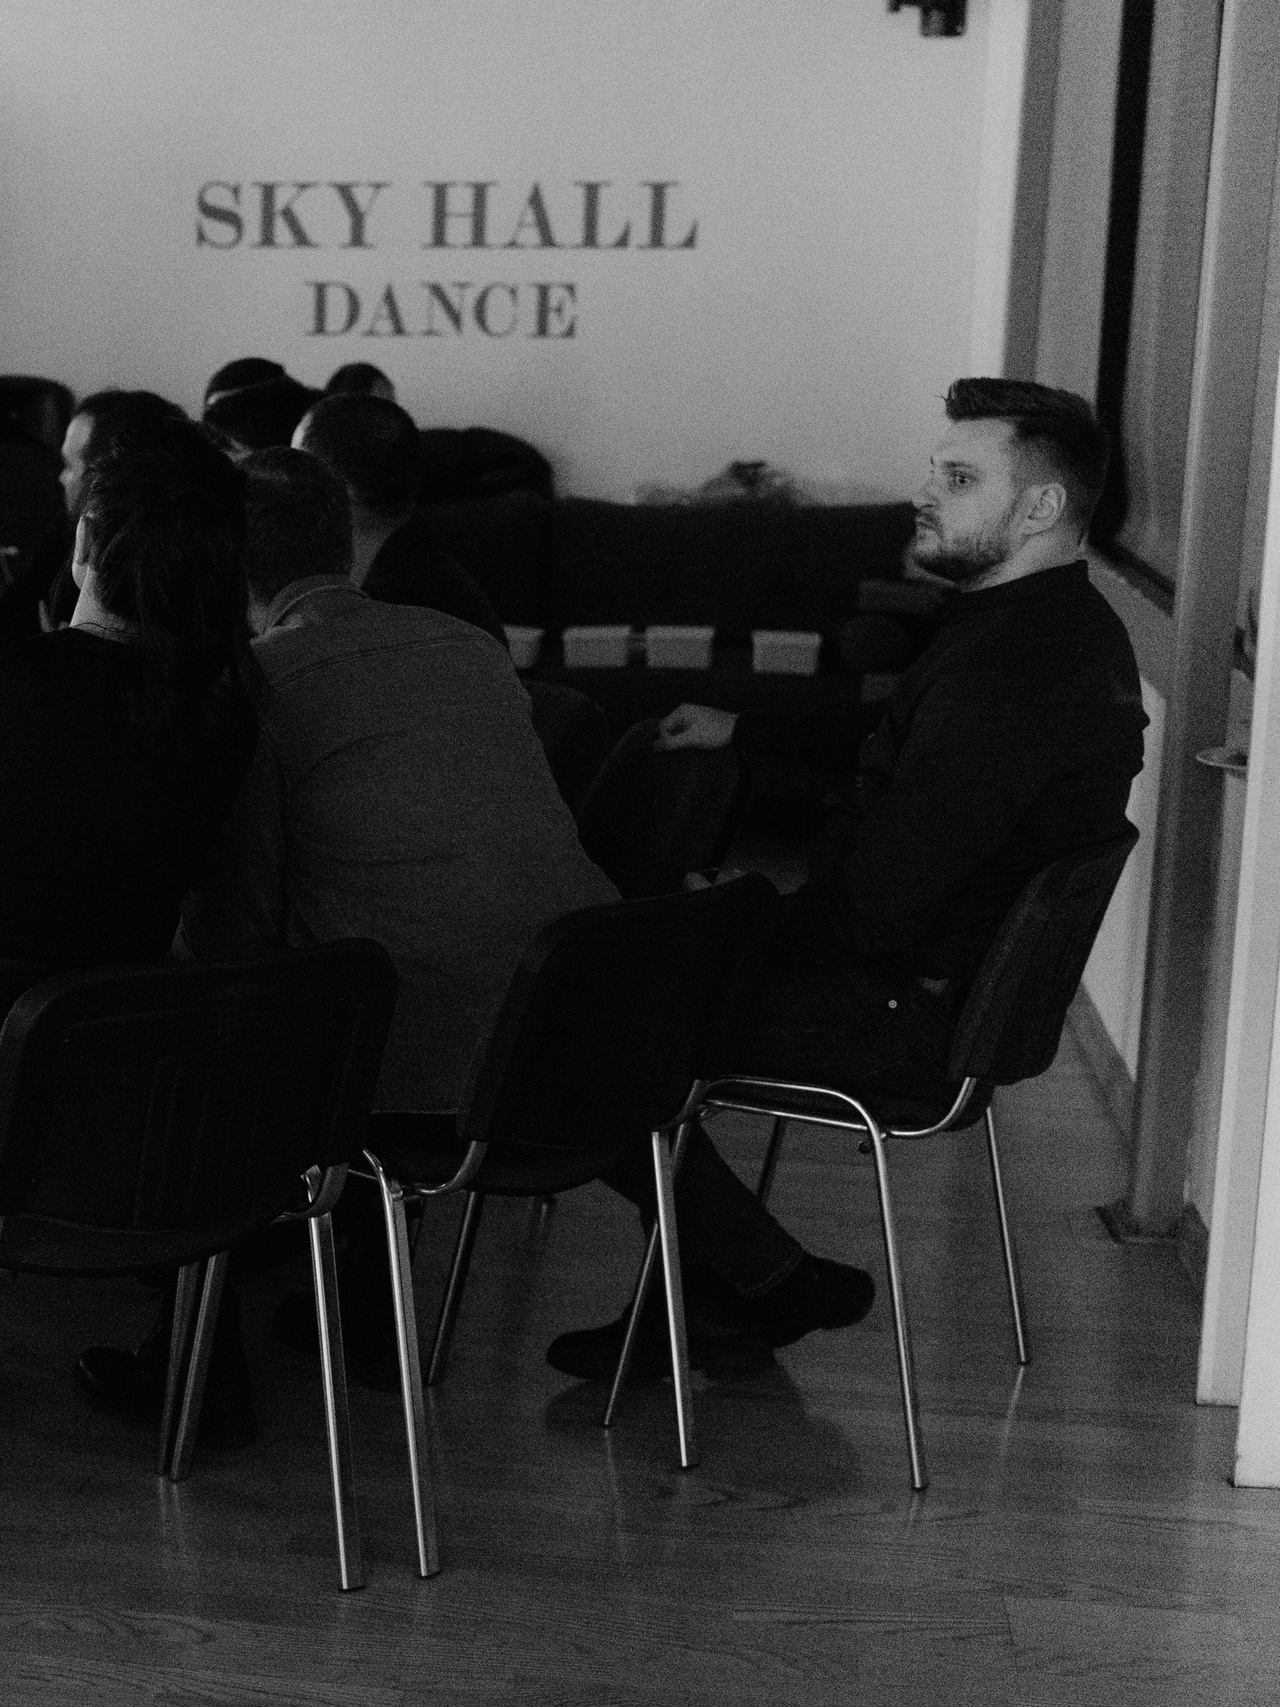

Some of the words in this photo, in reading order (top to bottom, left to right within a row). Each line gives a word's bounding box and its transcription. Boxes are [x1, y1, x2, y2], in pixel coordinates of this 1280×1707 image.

[194, 180, 388, 250] SKY
[422, 180, 699, 250] HALL
[306, 281, 577, 339] DANCE
